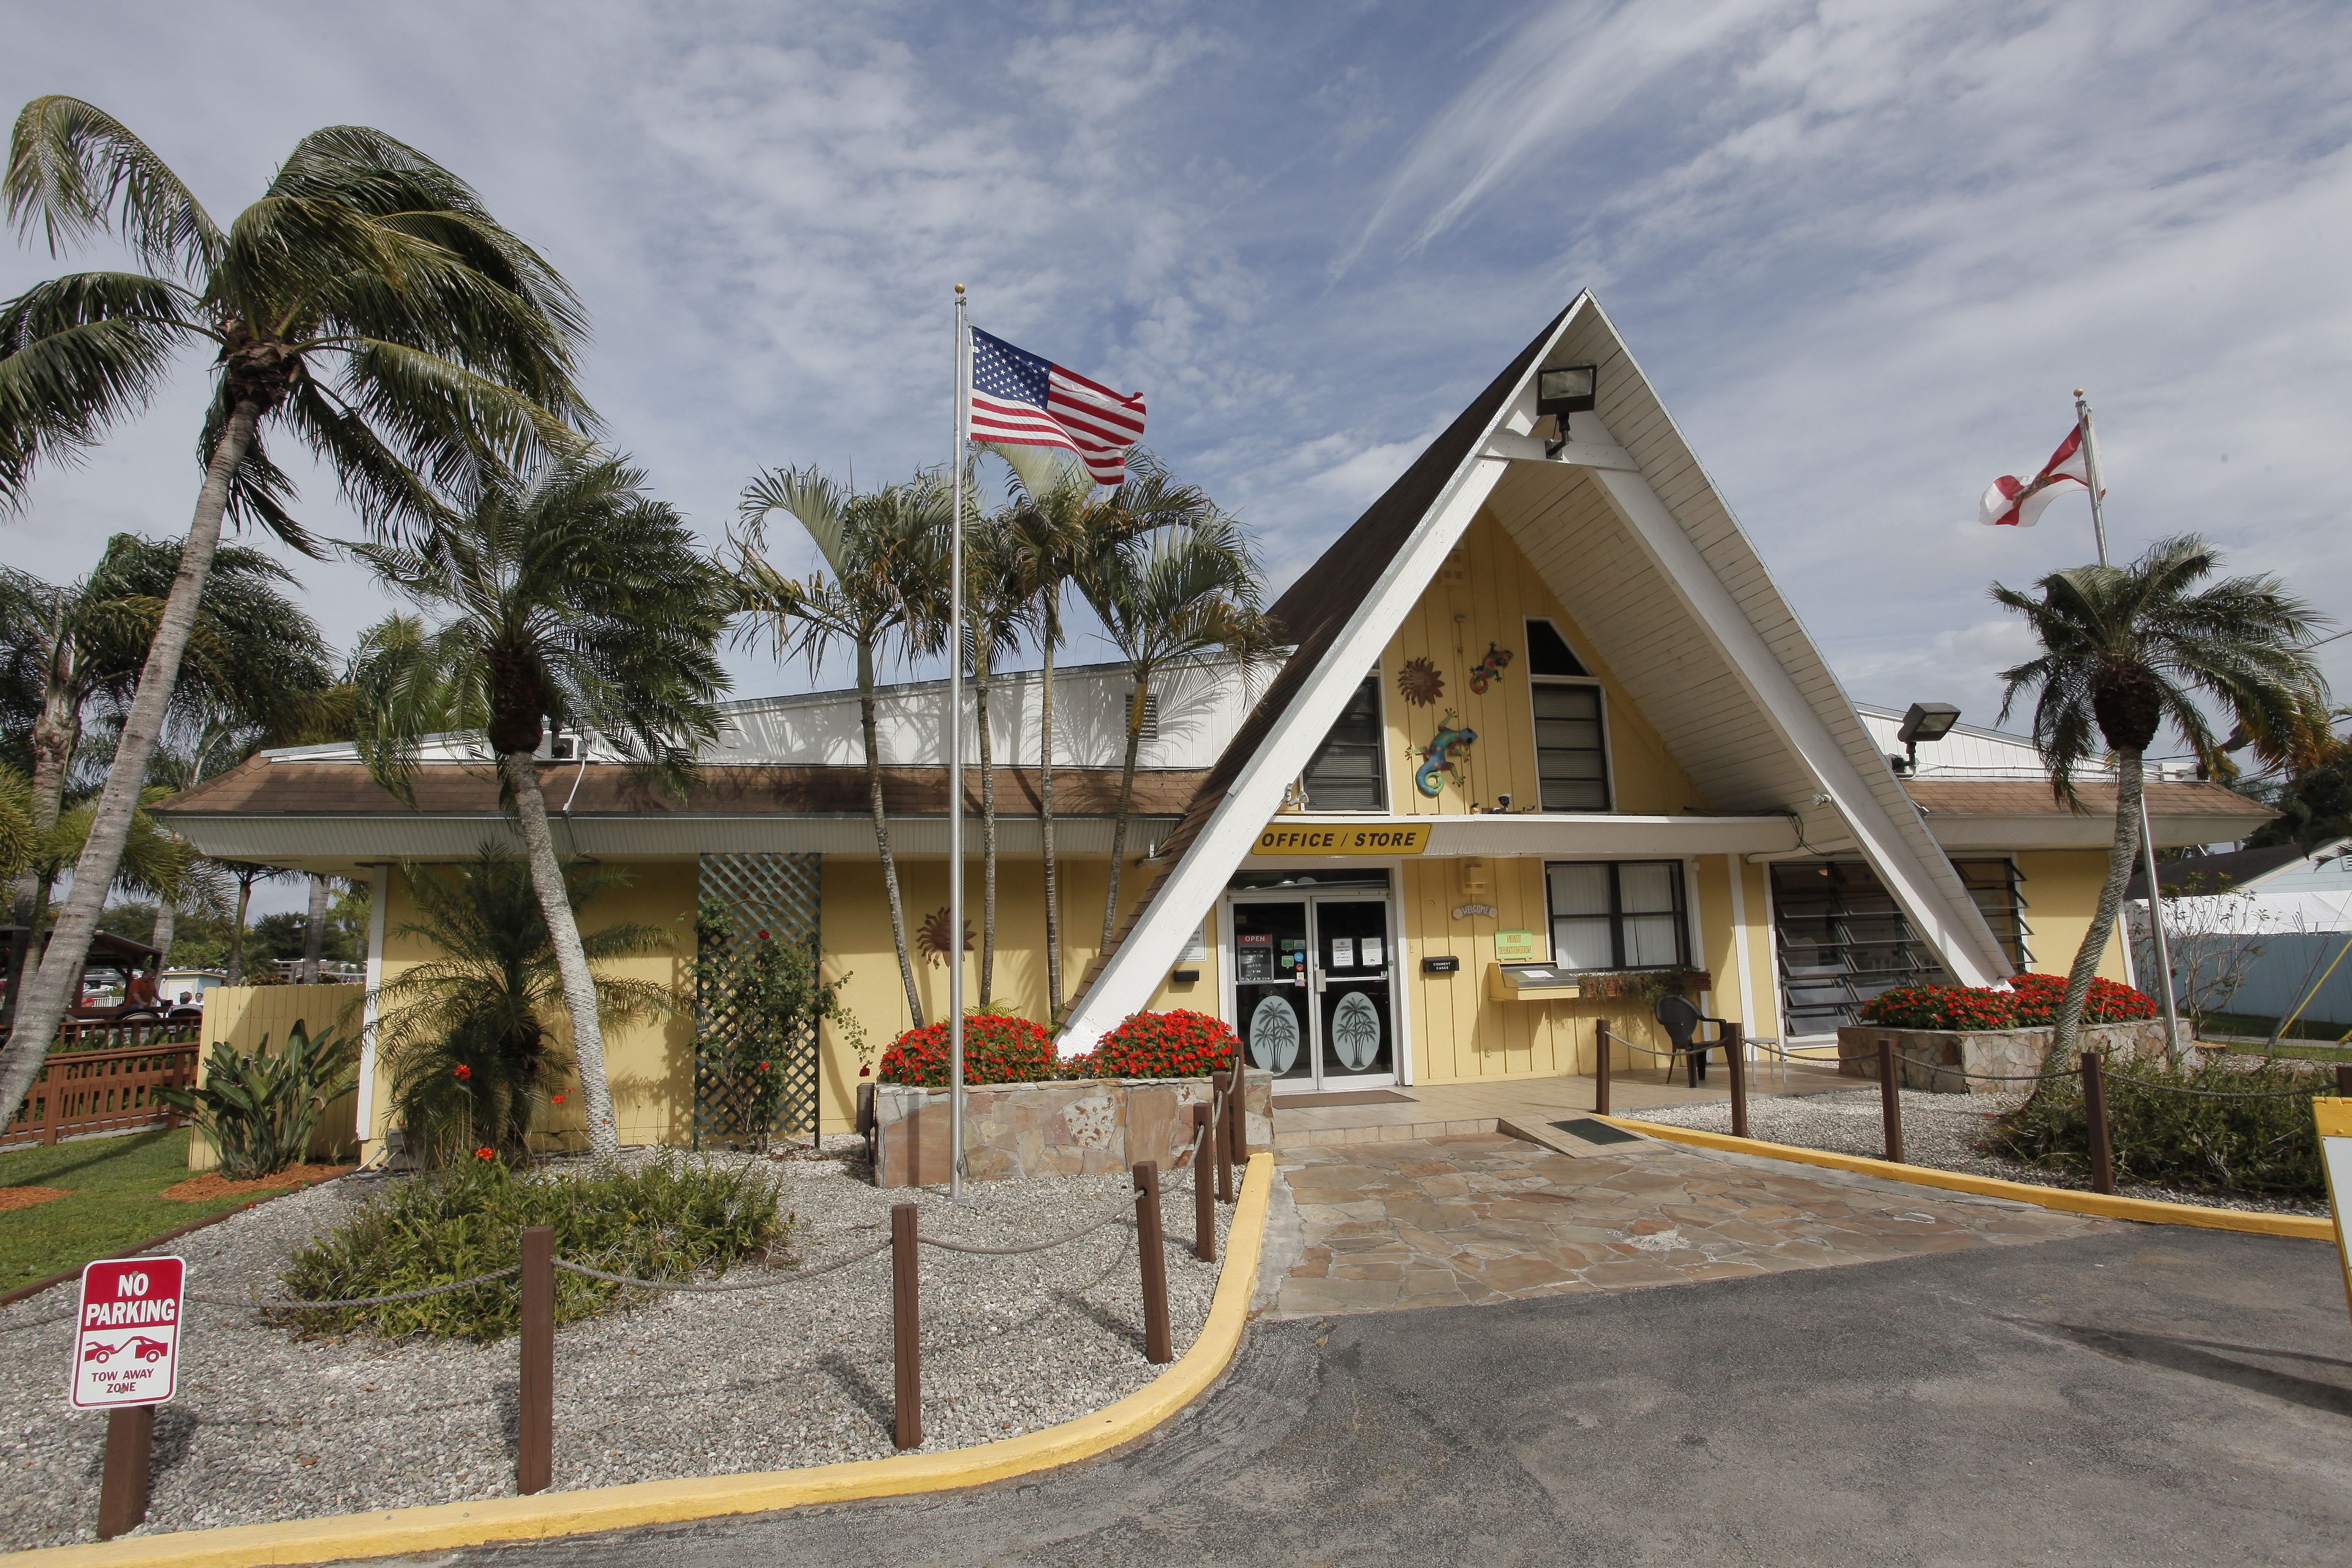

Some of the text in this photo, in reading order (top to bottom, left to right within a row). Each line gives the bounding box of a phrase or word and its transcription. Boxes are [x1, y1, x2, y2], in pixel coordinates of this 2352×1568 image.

[1261, 832, 1416, 847] OFFICE / STORE
[1461, 904, 1490, 914] WELCOME
[1507, 934, 1521, 943] NIGHT
[118, 1273, 149, 1297] NO
[85, 1298, 176, 1327] PARKING
[91, 1368, 154, 1382] TOW AWAY
[106, 1381, 137, 1393] ZONE
